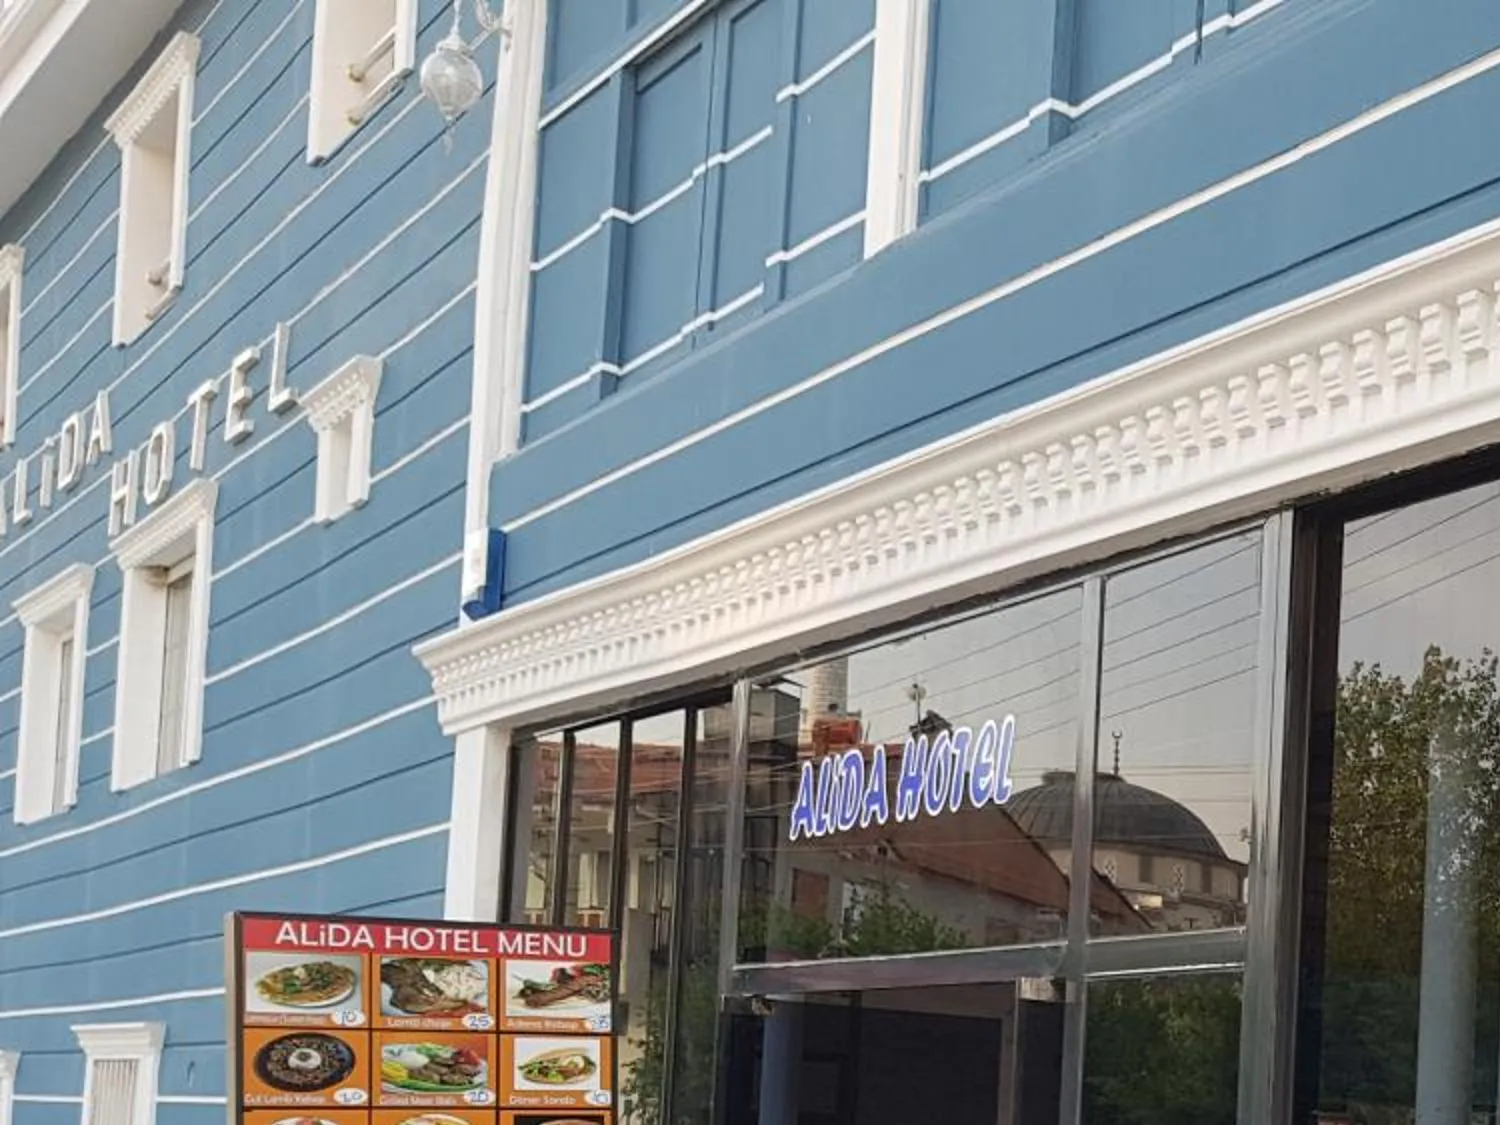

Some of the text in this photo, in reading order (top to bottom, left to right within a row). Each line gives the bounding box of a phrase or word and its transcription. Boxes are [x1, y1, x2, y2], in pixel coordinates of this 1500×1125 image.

[108, 322, 300, 537] HOTEL
[896, 714, 1015, 822] HOTEL
[385, 926, 489, 954] HOTEL
[498, 932, 588, 958] MENU
